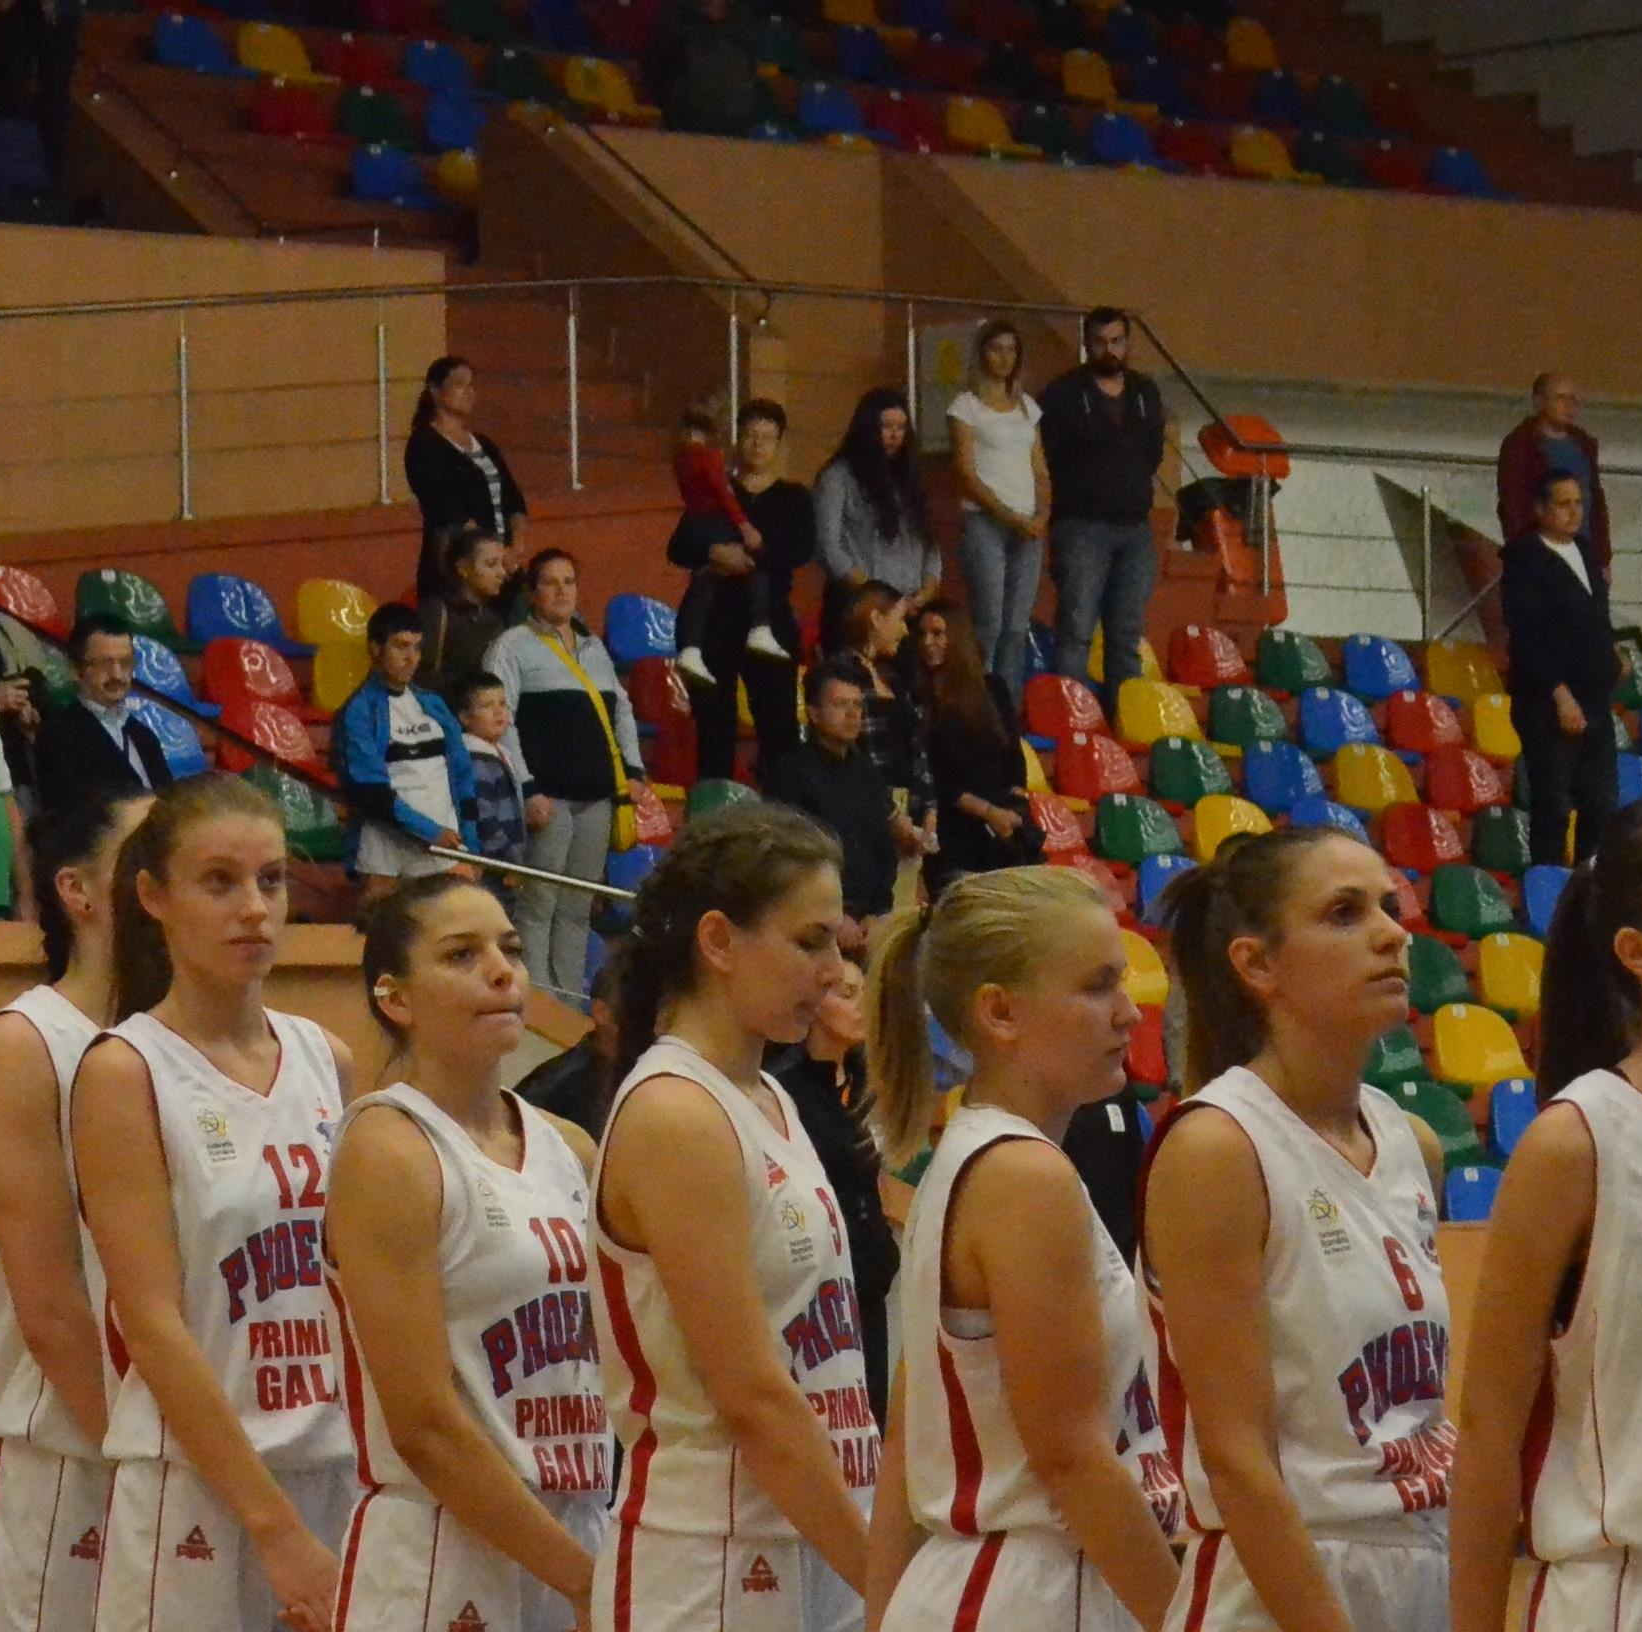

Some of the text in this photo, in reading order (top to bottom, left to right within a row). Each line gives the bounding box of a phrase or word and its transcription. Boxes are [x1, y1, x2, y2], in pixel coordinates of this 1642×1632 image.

[263, 1144, 325, 1210] 12
[219, 1219, 324, 1325] PHOE
[529, 1217, 588, 1284] 10
[1383, 1235, 1425, 1312] 6
[249, 1311, 332, 1360] PRIM
[257, 1363, 339, 1412] GAL
